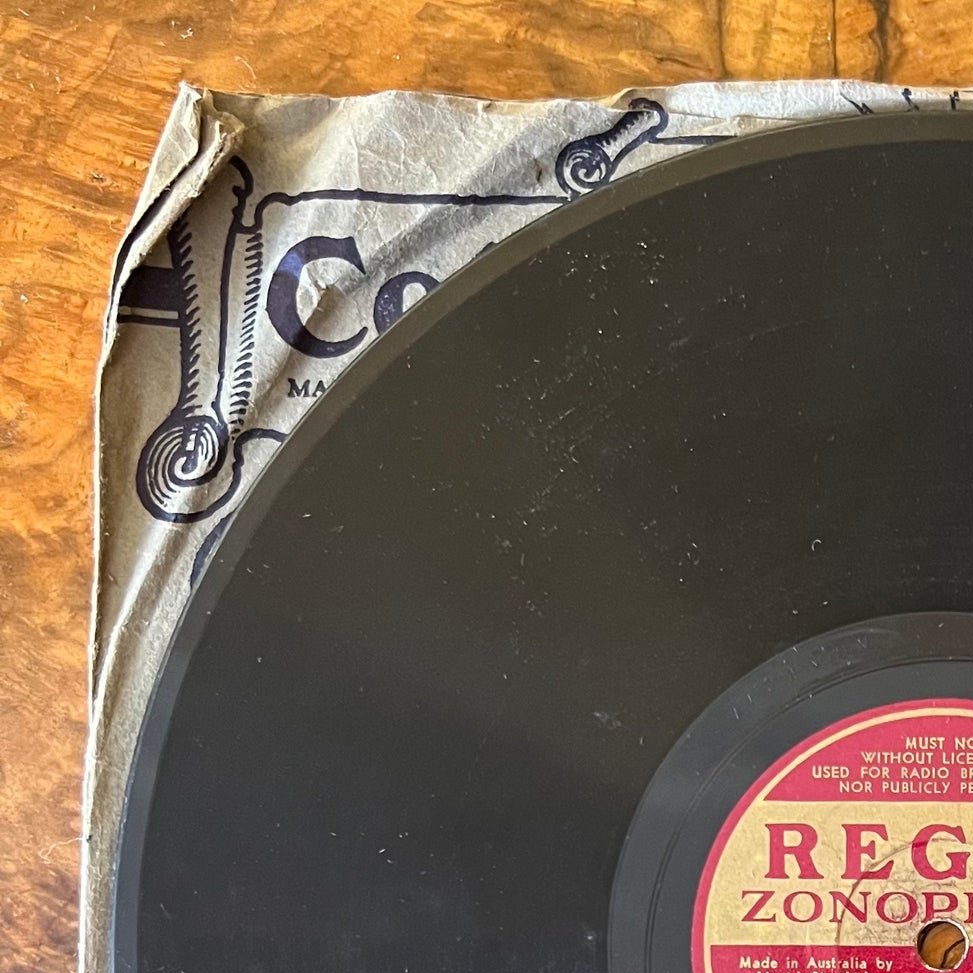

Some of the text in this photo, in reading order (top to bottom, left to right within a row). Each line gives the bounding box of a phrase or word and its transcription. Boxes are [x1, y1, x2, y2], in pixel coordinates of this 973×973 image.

[905, 737, 945, 750] MUST
[861, 751, 933, 765] WITHOUT
[812, 766, 850, 779] USED
[861, 766, 890, 779] FOR
[901, 766, 950, 779] RADIO
[839, 781, 873, 794] NOR
[882, 781, 951, 794] PUBLICLY
[739, 956, 778, 969] Made
[786, 957, 799, 969] in
[806, 957, 867, 969] Australia
[876, 957, 893, 971] by
